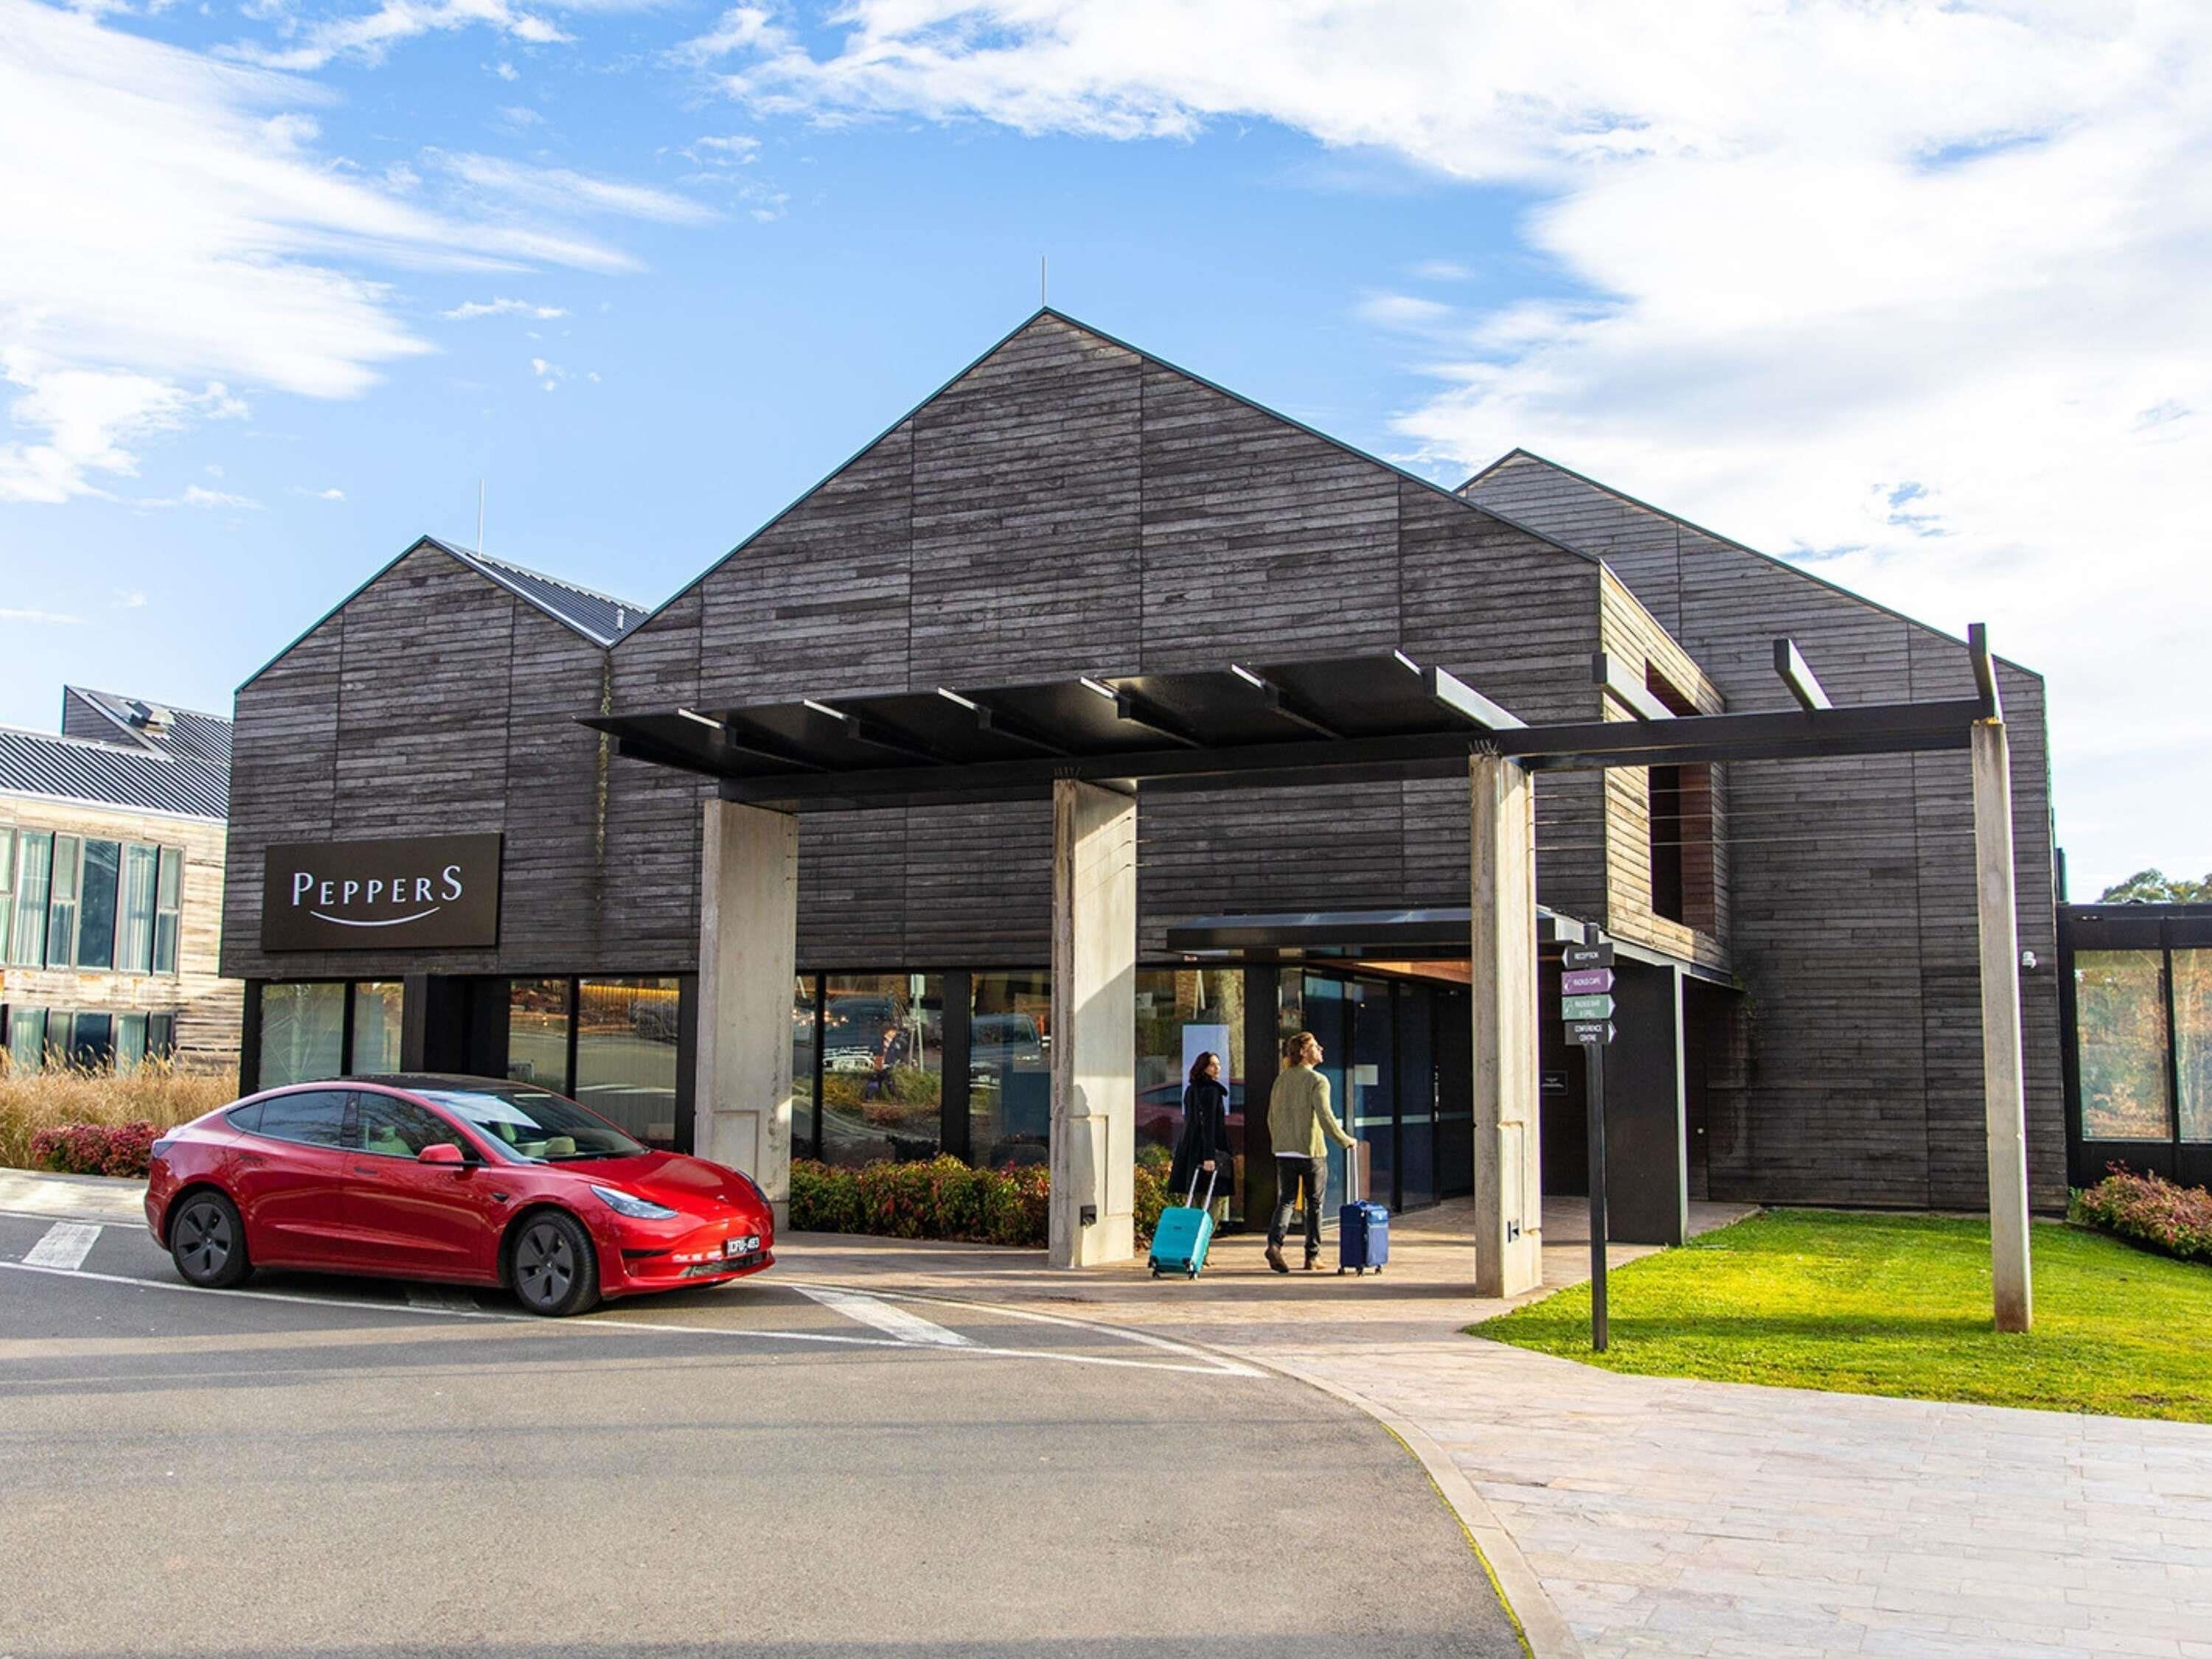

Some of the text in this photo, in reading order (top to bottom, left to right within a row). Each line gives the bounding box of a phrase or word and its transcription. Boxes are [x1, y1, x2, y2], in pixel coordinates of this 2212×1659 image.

[292, 865, 462, 906] PEPPERS
[1573, 951, 1599, 961] RECEPTION
[1574, 1024, 1603, 1033] CONFERENCE
